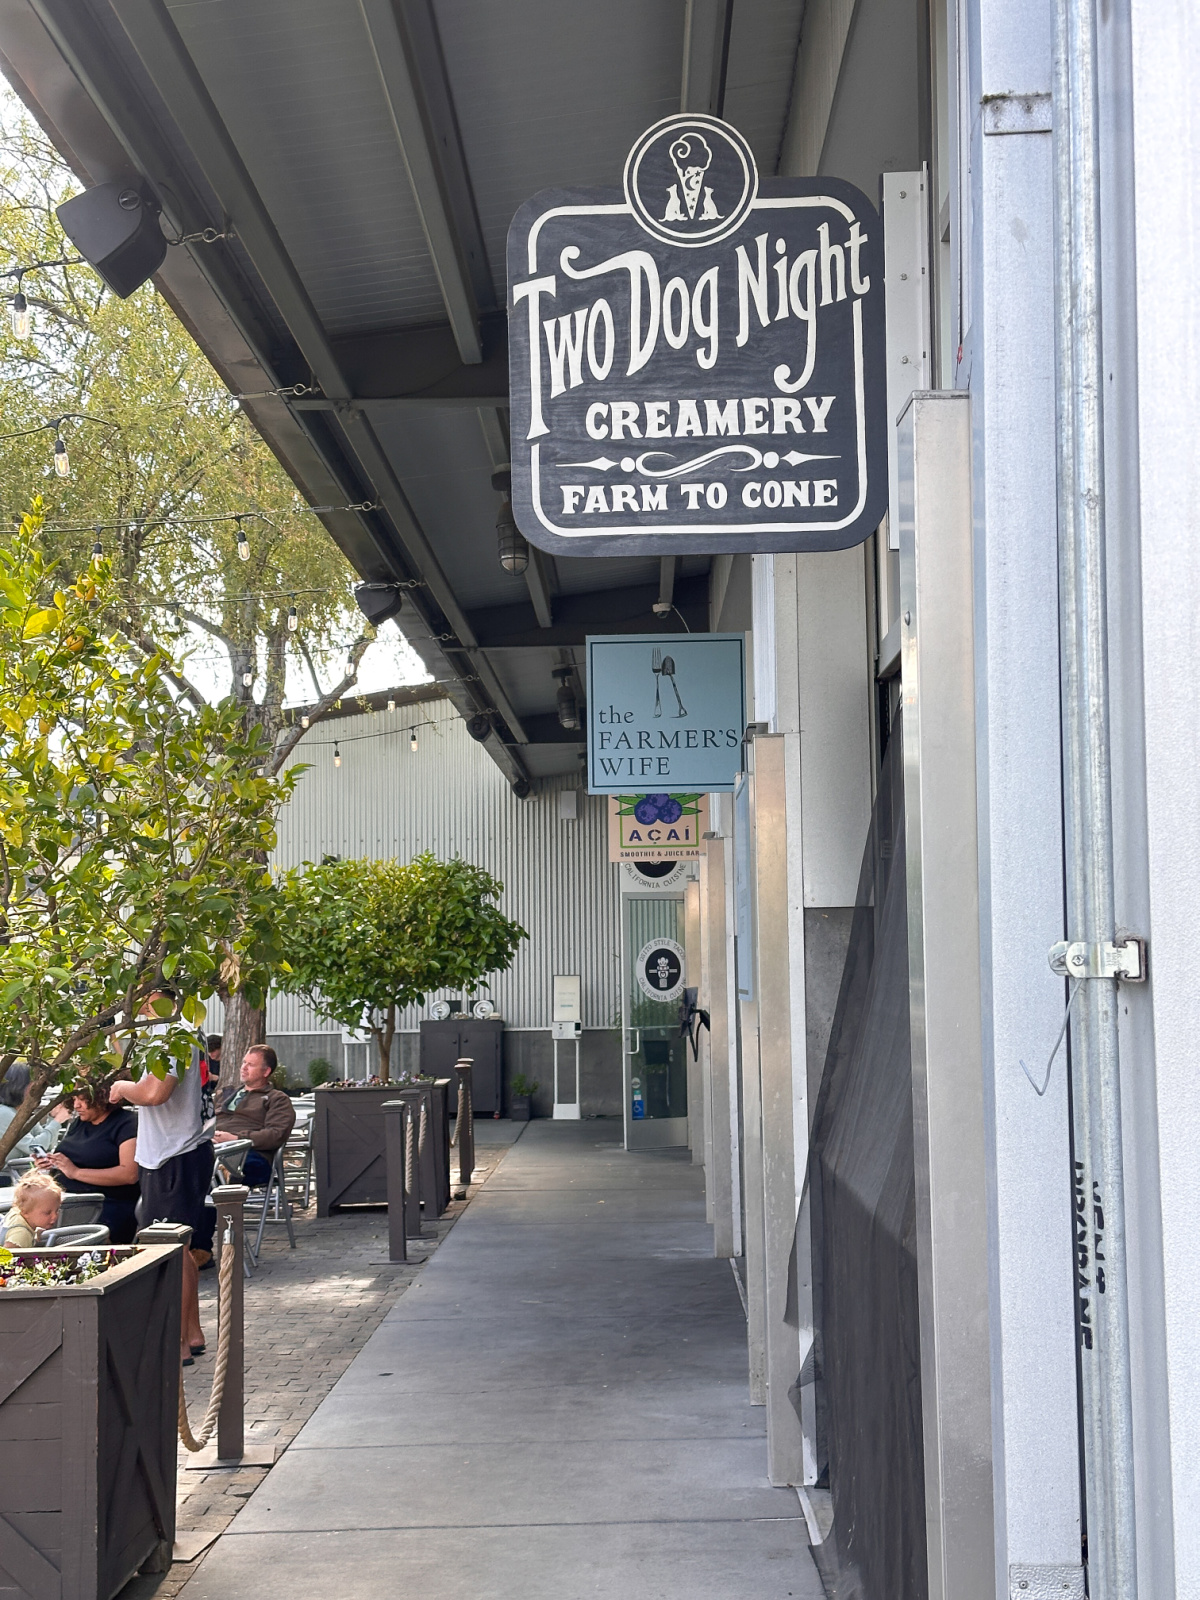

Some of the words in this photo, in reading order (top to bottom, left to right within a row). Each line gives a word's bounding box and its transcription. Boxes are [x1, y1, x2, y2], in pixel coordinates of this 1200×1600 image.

[560, 249, 720, 376] Dog
[735, 222, 870, 393] Night
[585, 395, 837, 441] CREAMERY
[560, 484, 669, 515] FARM
[681, 482, 729, 512] TO
[741, 478, 839, 509] CONE
[599, 705, 634, 724] the
[598, 729, 739, 750] FARMER'S
[599, 757, 671, 777] WIFE
[625, 863, 660, 889] CALIFORNIA
[663, 863, 686, 887] CUISINE
[653, 939, 672, 947] STYLE
[639, 977, 668, 1001] CALIFORNIA
